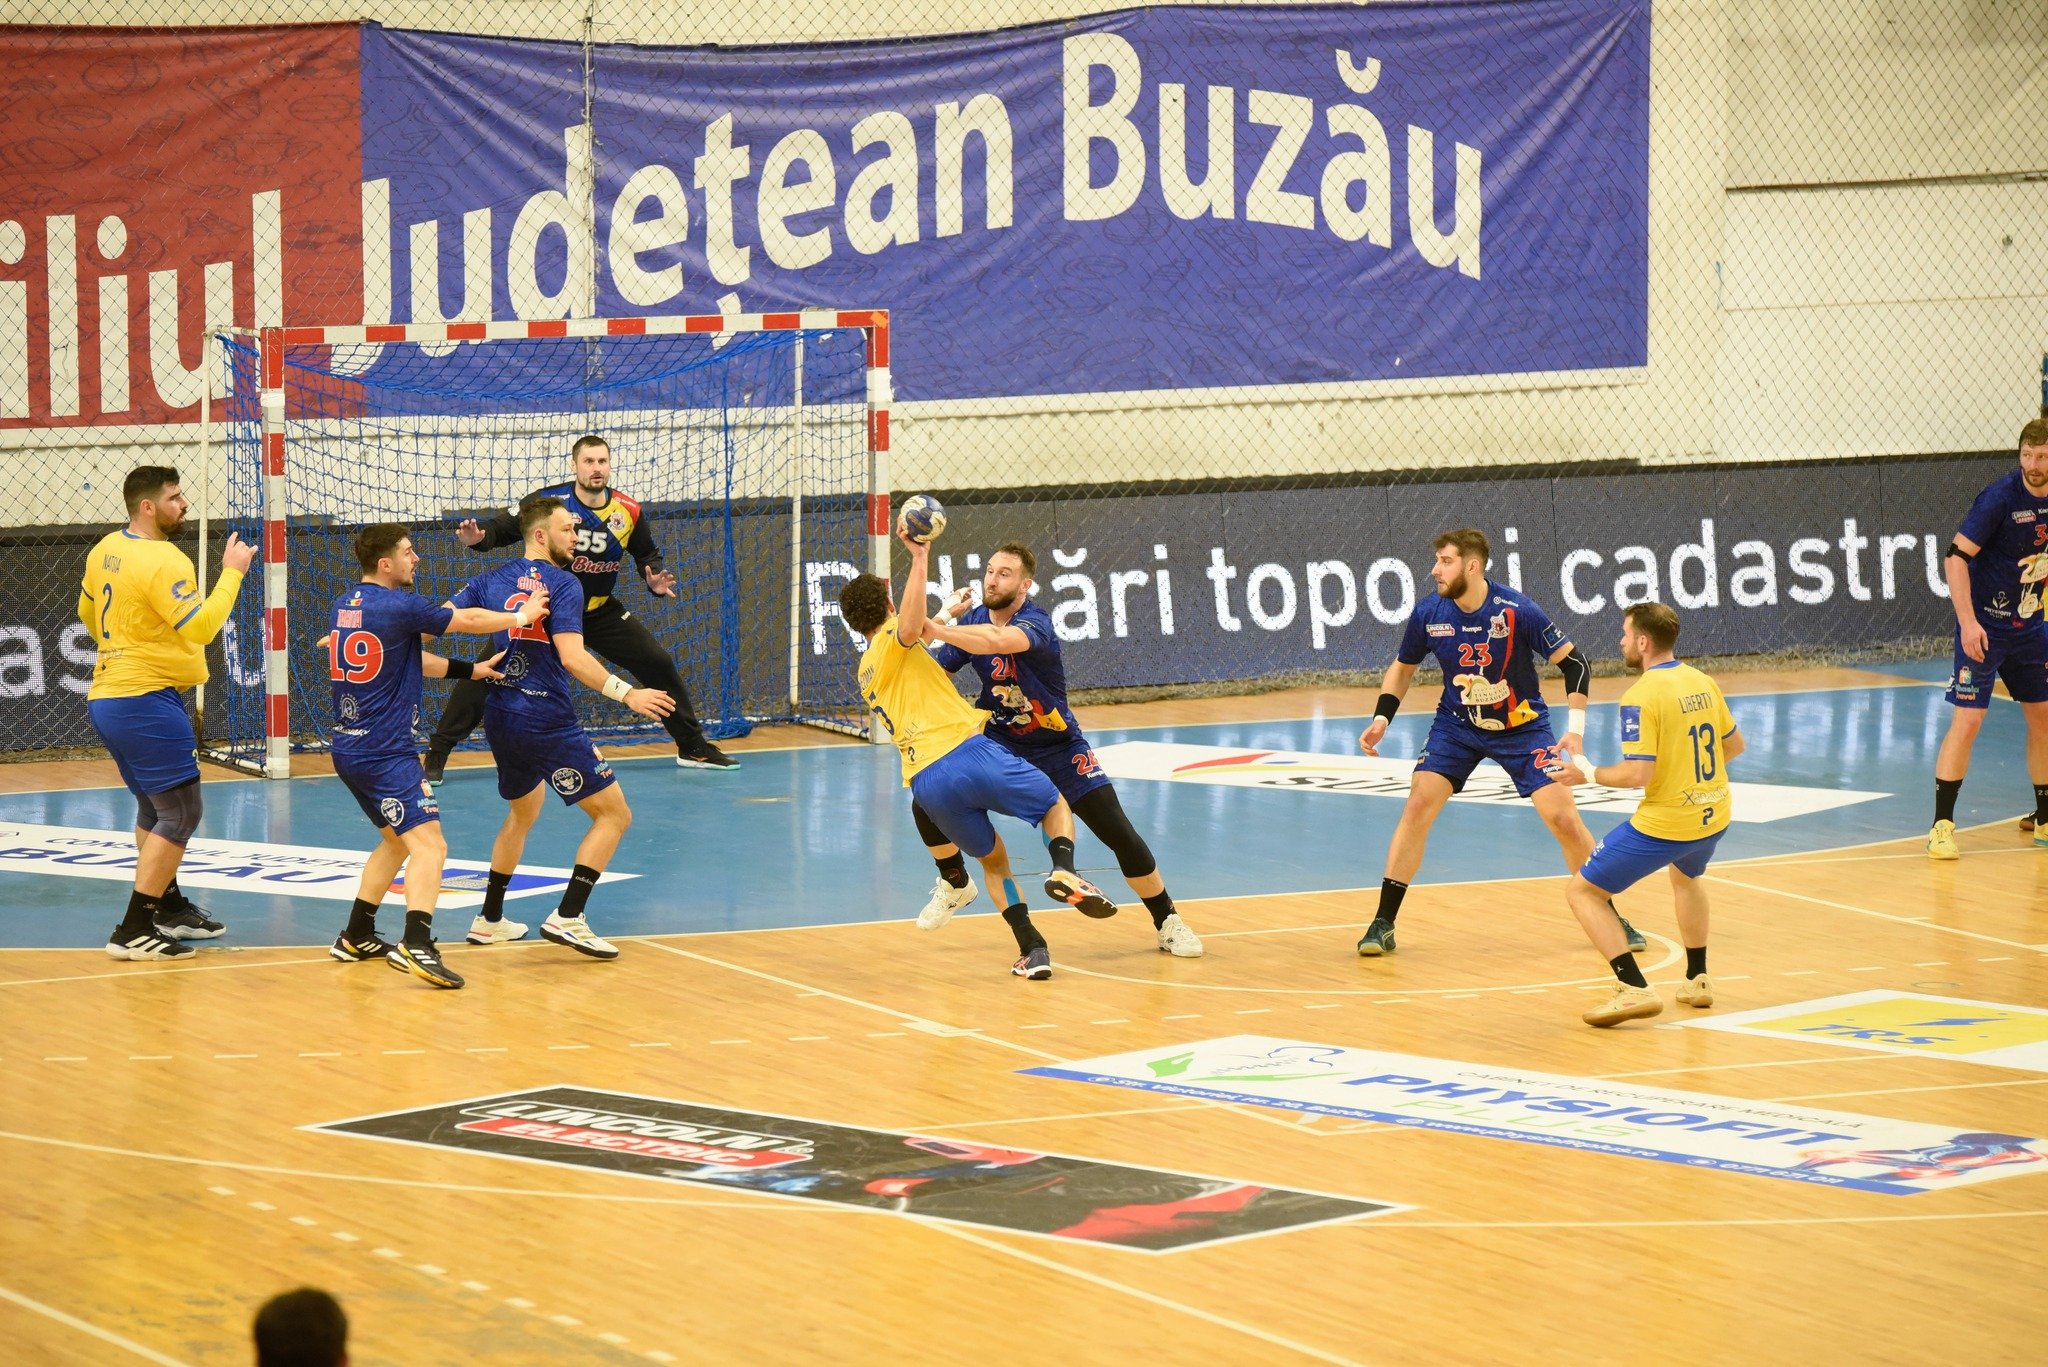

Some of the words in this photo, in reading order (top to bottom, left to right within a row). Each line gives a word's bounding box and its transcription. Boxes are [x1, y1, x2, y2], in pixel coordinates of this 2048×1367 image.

[330, 94, 1013, 377] Județean
[1063, 32, 1482, 281] Buzău
[575, 529, 607, 553] 55
[2034, 523, 2048, 546] 3
[101, 582, 112, 639] 2
[1206, 546, 1417, 650] topo
[330, 630, 383, 684] 19
[1458, 643, 1492, 667] 23
[1679, 692, 1713, 714] LIBERTY
[1688, 723, 1716, 784] 13
[1797, 1024, 1957, 1044] TRS
[486, 1103, 786, 1151] LINCOLN
[1341, 1073, 1863, 1146] PHYSIOFIT
[1391, 1100, 1647, 1137] PLUS
[498, 1123, 756, 1163] ELECTRIC
[1425, 1121, 1660, 1157] www.physiofitplus.ro
